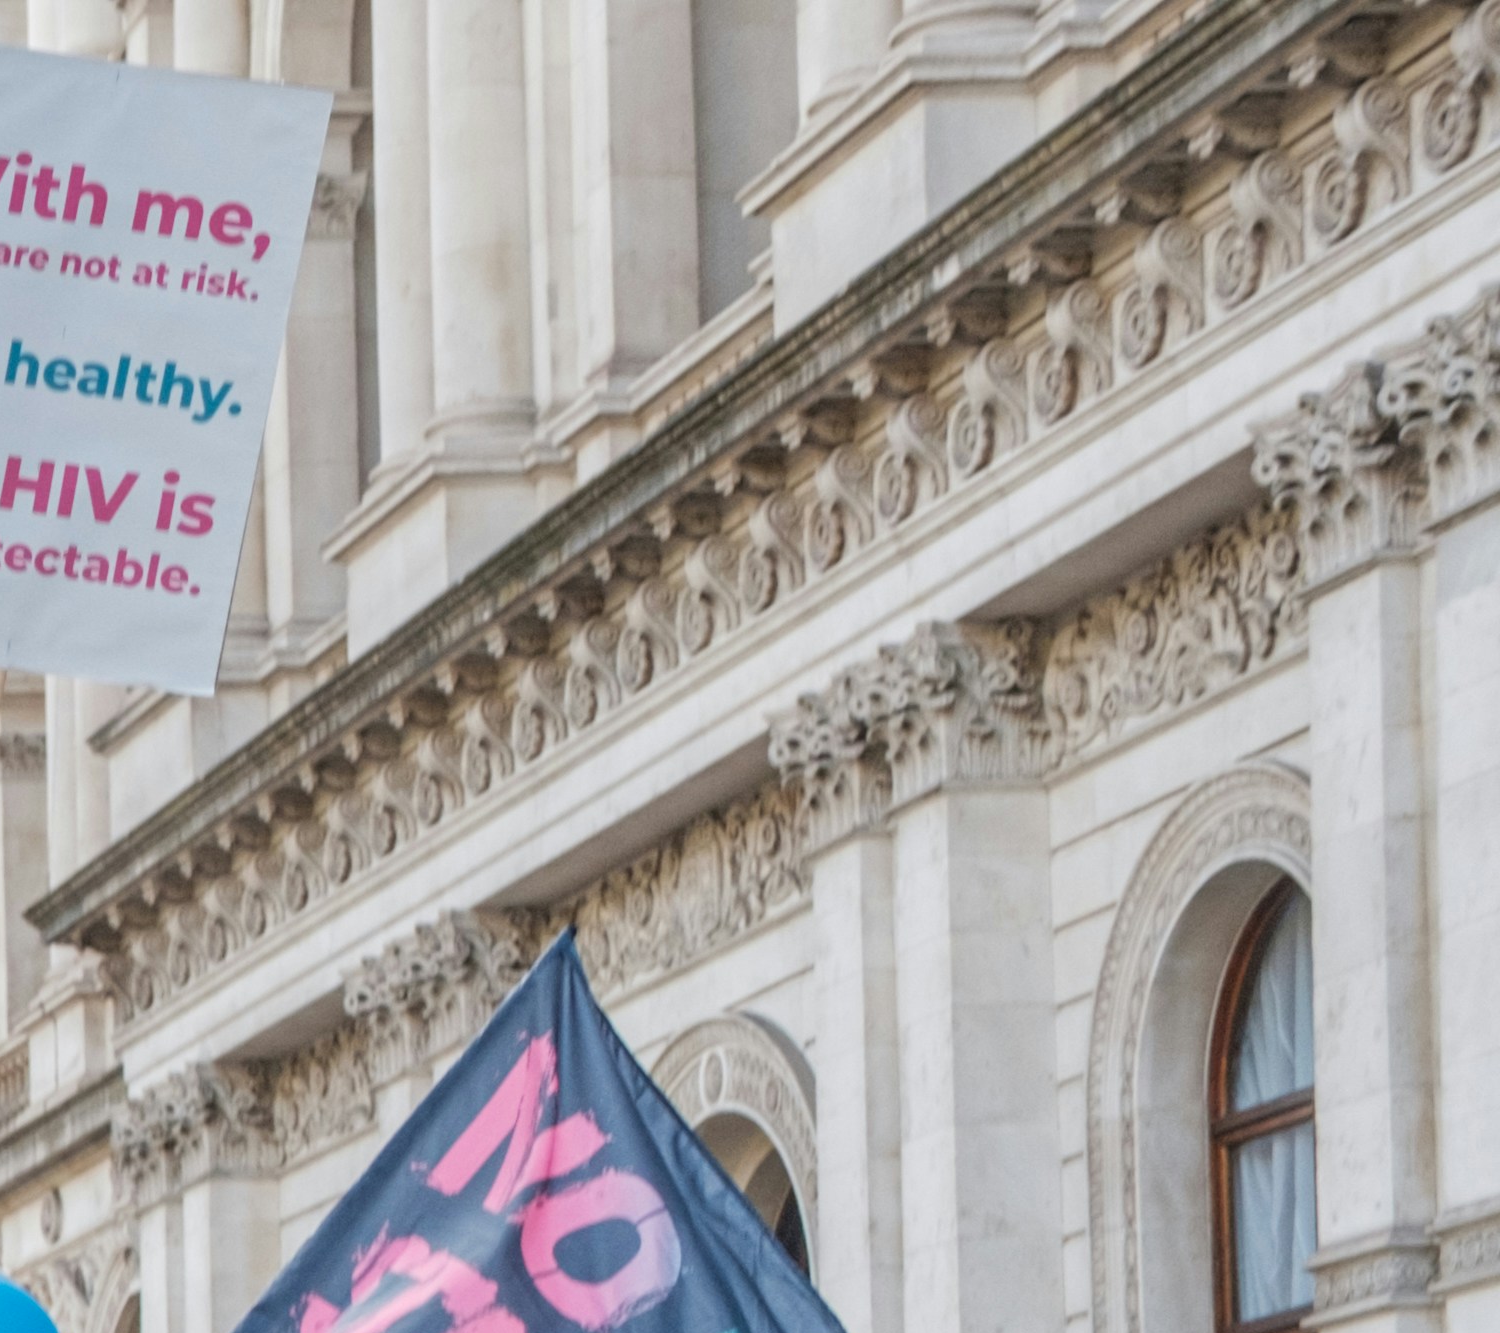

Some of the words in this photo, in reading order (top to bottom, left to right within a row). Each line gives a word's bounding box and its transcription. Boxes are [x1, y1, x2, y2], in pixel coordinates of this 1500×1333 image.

[131, 184, 272, 261] me,
[60, 252, 120, 283] not
[132, 260, 170, 289] at
[181, 264, 260, 302] risk.
[5, 339, 242, 424] healthy.
[0, 455, 140, 526] HIV
[155, 471, 217, 537] is
[411, 1028, 682, 1332] NO
